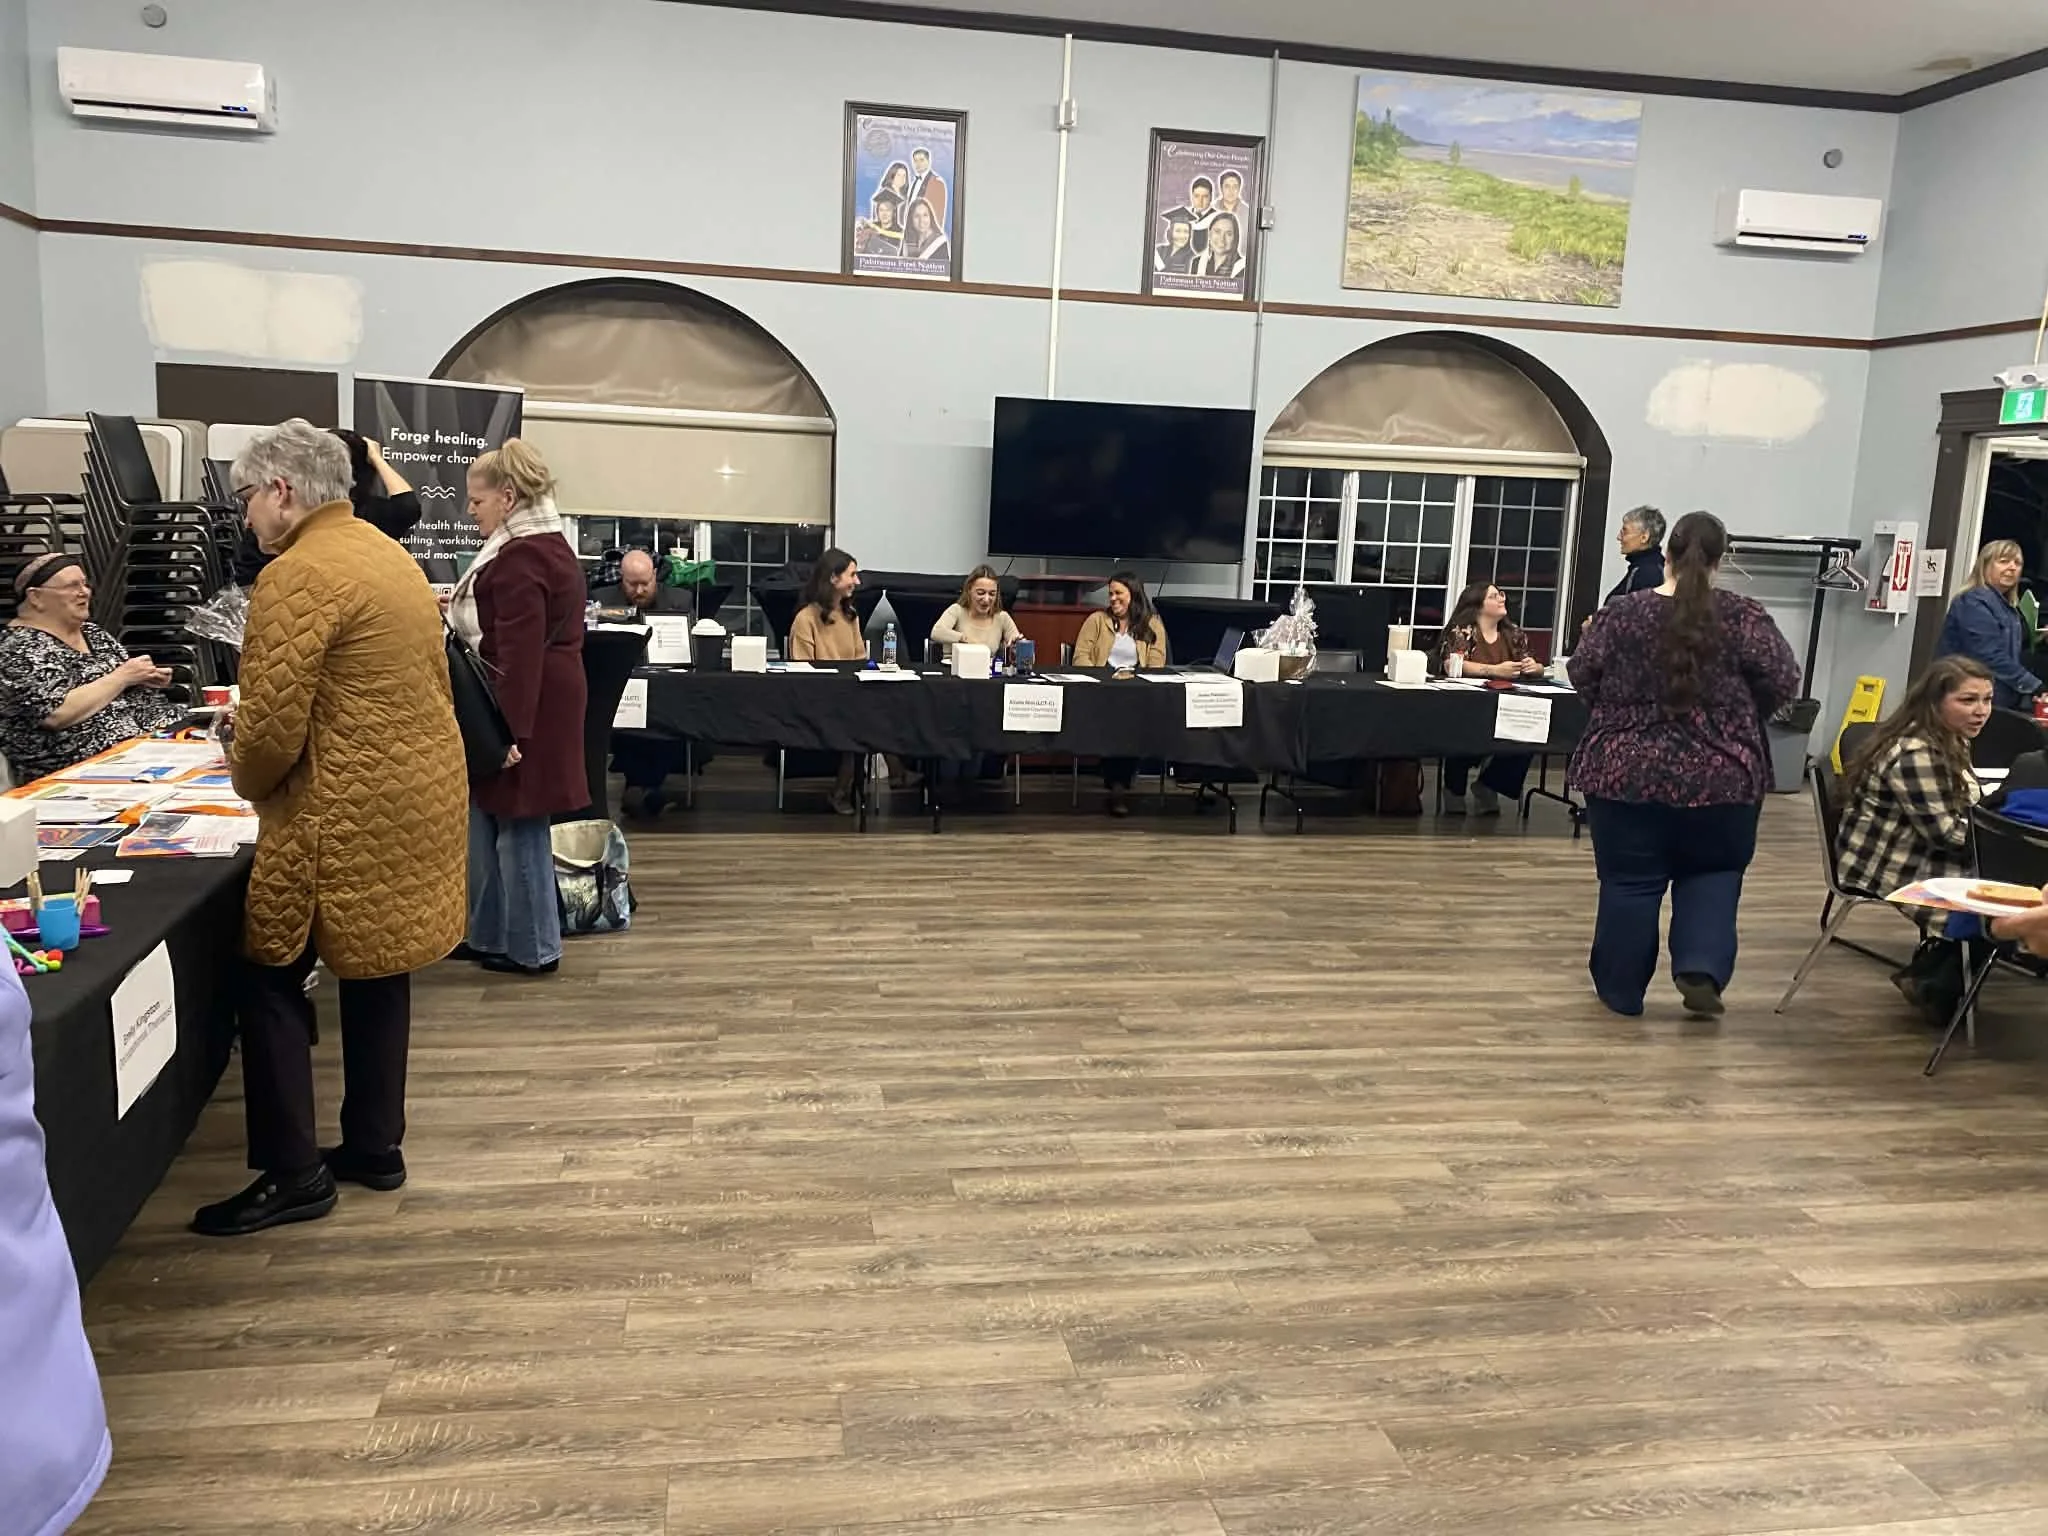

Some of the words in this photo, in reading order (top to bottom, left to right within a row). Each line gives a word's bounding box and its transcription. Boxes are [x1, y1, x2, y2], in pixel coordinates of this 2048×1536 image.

[390, 427, 430, 445] Forge
[435, 429, 489, 449] healing.
[382, 446, 443, 463] Empower
[447, 450, 477, 464] chan
[419, 519, 450, 531] health
[454, 520, 480, 531] thera
[400, 534, 435, 547] sulting,
[439, 535, 486, 547] workshop
[412, 549, 431, 559] and
